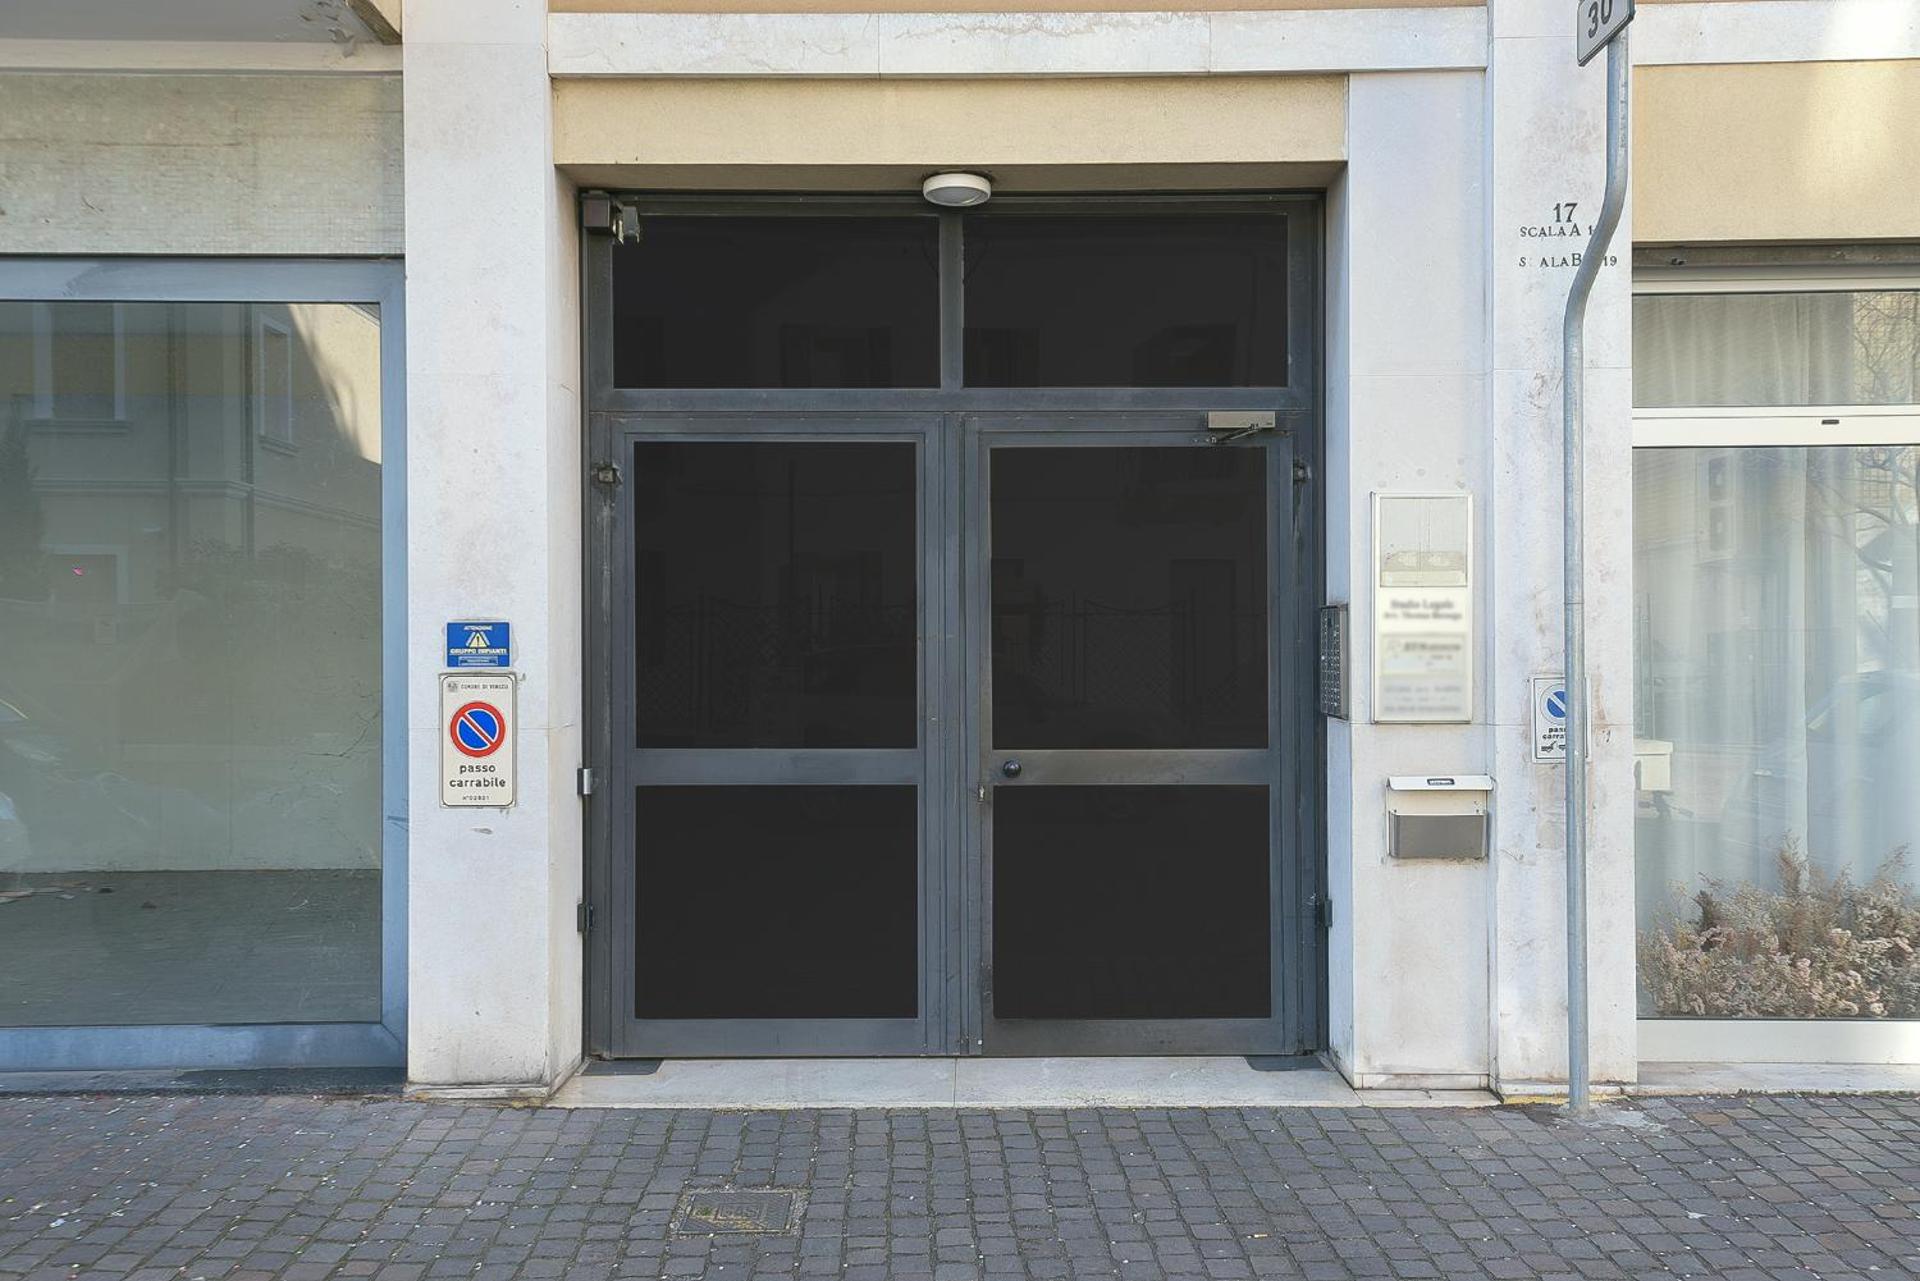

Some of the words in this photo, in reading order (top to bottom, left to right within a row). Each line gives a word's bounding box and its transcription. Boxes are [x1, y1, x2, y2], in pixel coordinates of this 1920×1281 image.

[1588, 0, 1613, 38] 30
[1553, 202, 1578, 223] 17
[1520, 226, 1567, 238] SCALA
[1569, 223, 1581, 237] A
[1519, 257, 1569, 268] SALA
[1571, 253, 1582, 267] B
[1604, 255, 1618, 267] 19
[459, 764, 496, 774] passo
[449, 777, 506, 788] carrabile
